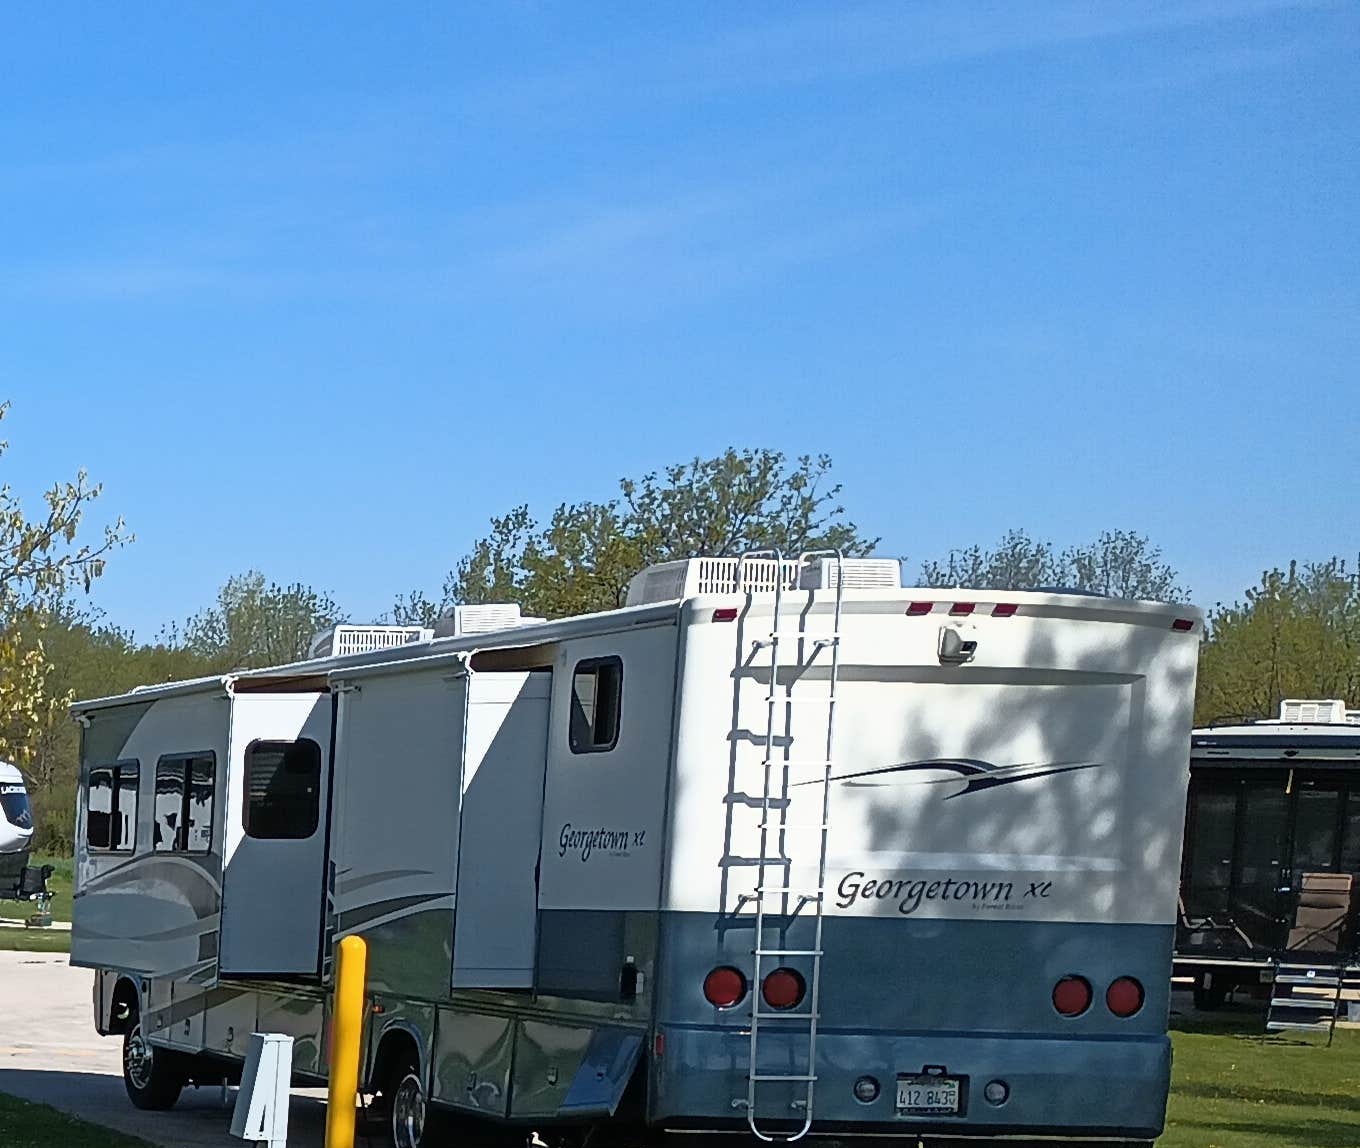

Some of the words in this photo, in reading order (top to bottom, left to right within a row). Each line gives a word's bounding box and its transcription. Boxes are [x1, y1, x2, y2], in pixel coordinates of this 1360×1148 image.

[559, 823, 628, 862] Georgetown
[836, 871, 1013, 914] Georgetown
[900, 1090, 921, 1105] 412
[927, 1090, 948, 1105] 843
